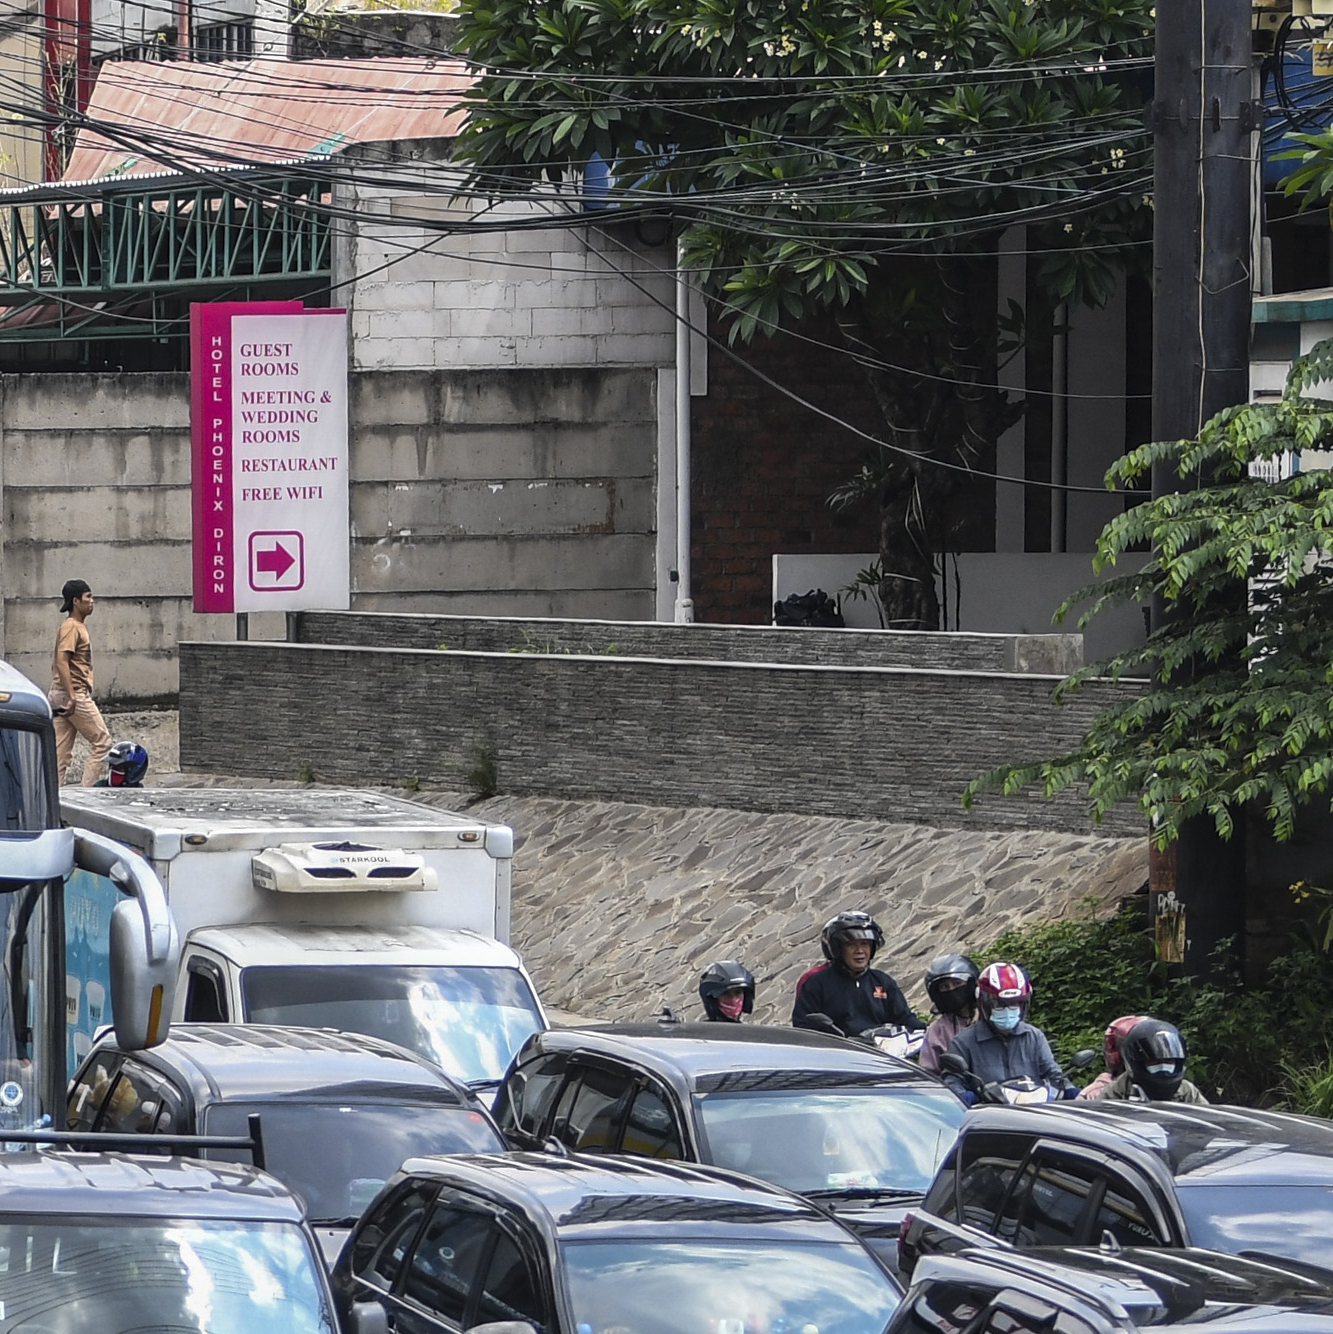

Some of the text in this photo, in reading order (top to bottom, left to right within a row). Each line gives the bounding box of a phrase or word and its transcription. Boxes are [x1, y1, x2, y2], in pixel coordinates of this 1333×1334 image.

[240, 343, 293, 357] GUEST
[241, 362, 299, 376] ROOMS
[241, 390, 332, 405] MEETING &
[241, 410, 319, 424] WEDDING
[242, 429, 301, 444] ROOMS
[211, 336, 225, 594] HOTEL PHOENIX DIRON
[241, 457, 338, 473] RESTAURANT
[242, 486, 324, 501] FREE WIFI
[339, 855, 390, 864] STARKOOL
